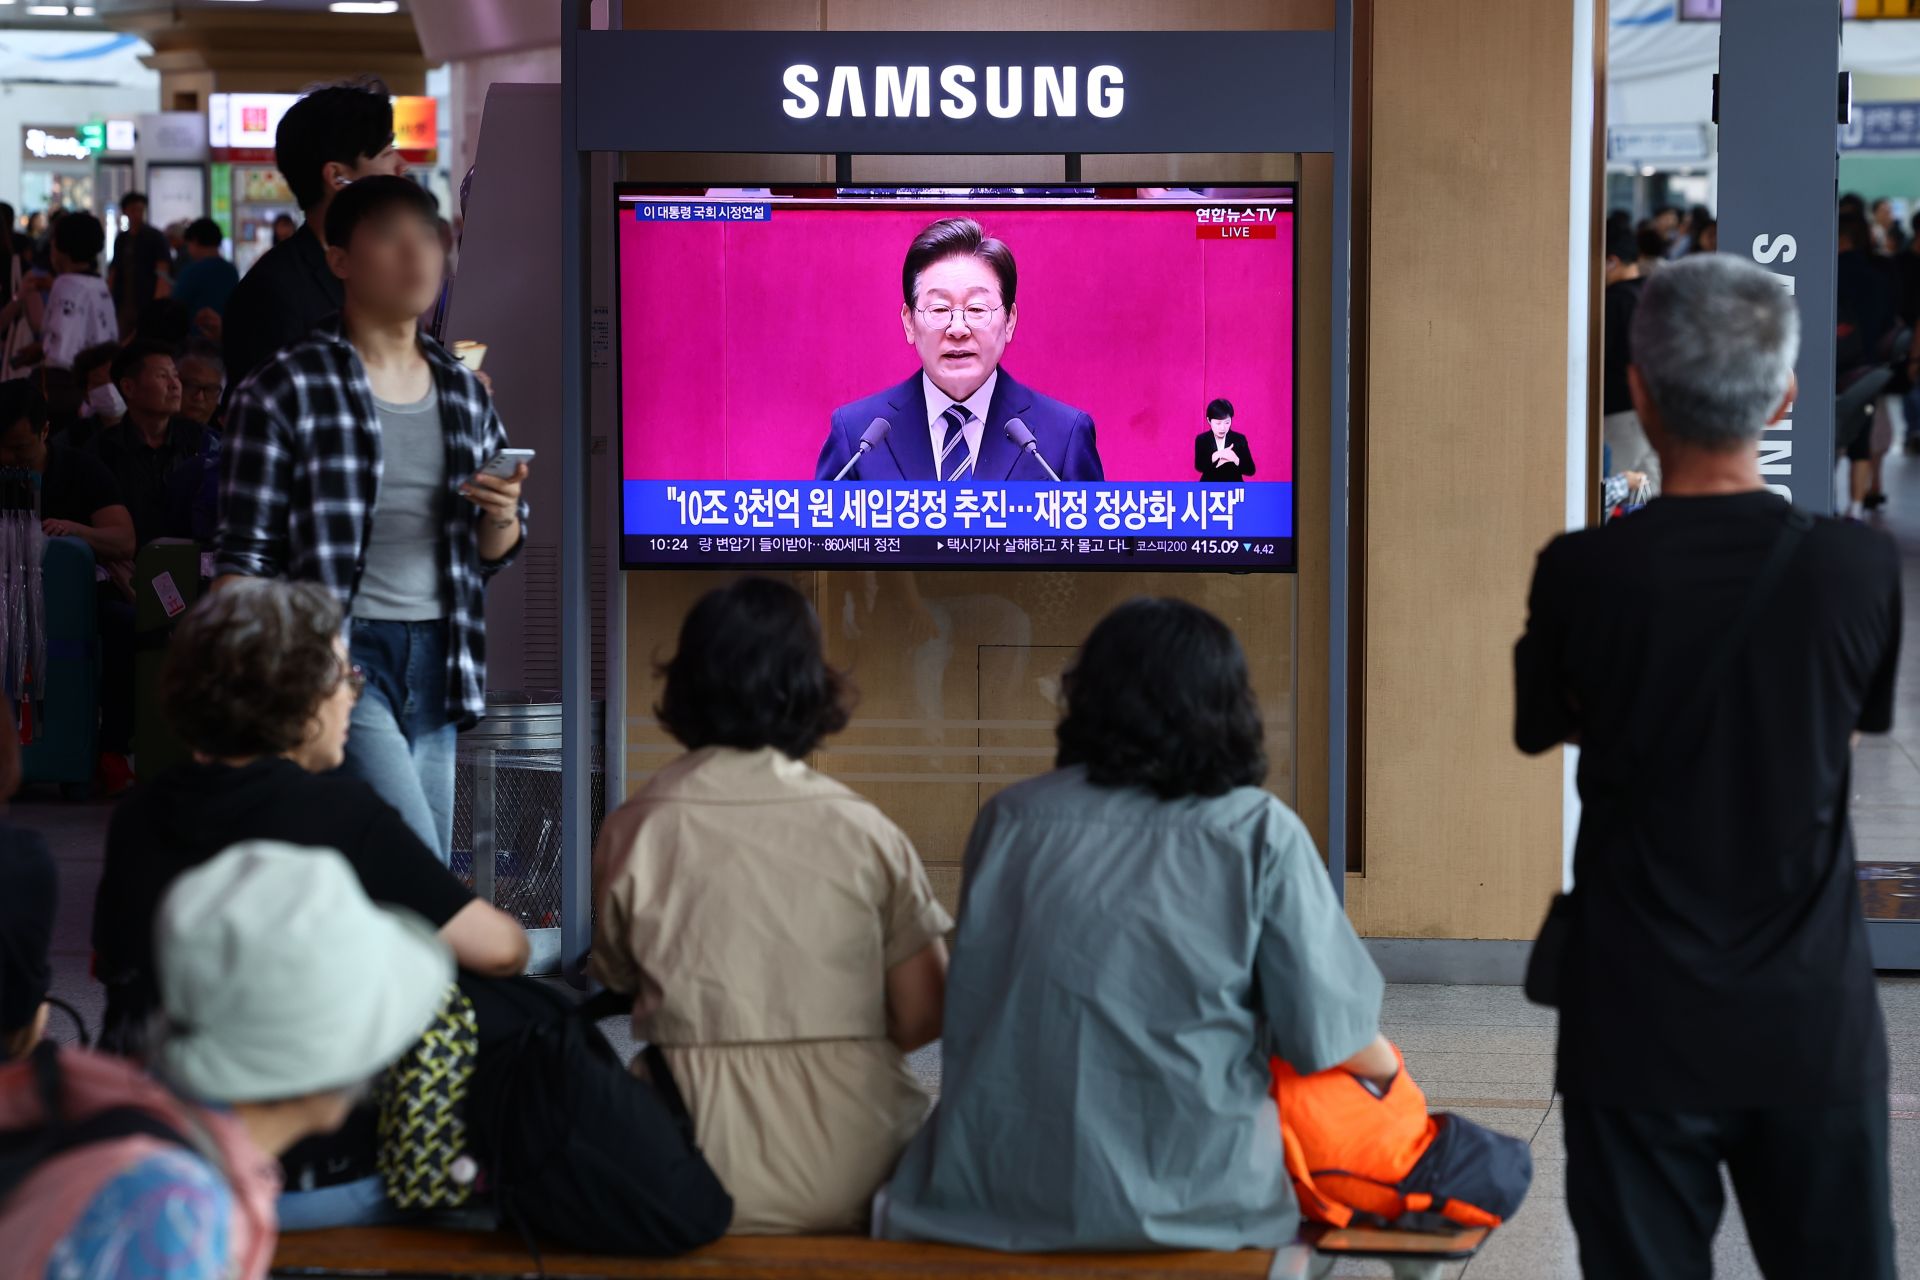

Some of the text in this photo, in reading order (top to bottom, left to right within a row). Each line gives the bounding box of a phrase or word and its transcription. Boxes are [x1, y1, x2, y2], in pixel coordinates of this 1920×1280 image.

[782, 64, 1125, 119] SAMSUNG
[643, 206, 764, 219] 이 대통령 국회 시정연설
[1195, 208, 1277, 223] 연합뉴스TV
[1221, 226, 1250, 237] LIVE
[733, 488, 800, 528] 3천억
[807, 488, 834, 528] 원
[839, 488, 947, 530] 세입경정
[1093, 489, 1176, 531] 정상화
[1180, 488, 1245, 531] 시작"
[649, 538, 689, 551] 10:24
[699, 537, 713, 552] 량
[716, 537, 755, 552] 변압기
[874, 537, 901, 553] 정전
[947, 537, 1001, 553] 택시기사
[1003, 538, 1057, 553] 살해하고
[1060, 538, 1075, 553] 차
[1077, 538, 1105, 553] 몰고
[1136, 540, 1275, 555] 코스피200 415.09 4.42
